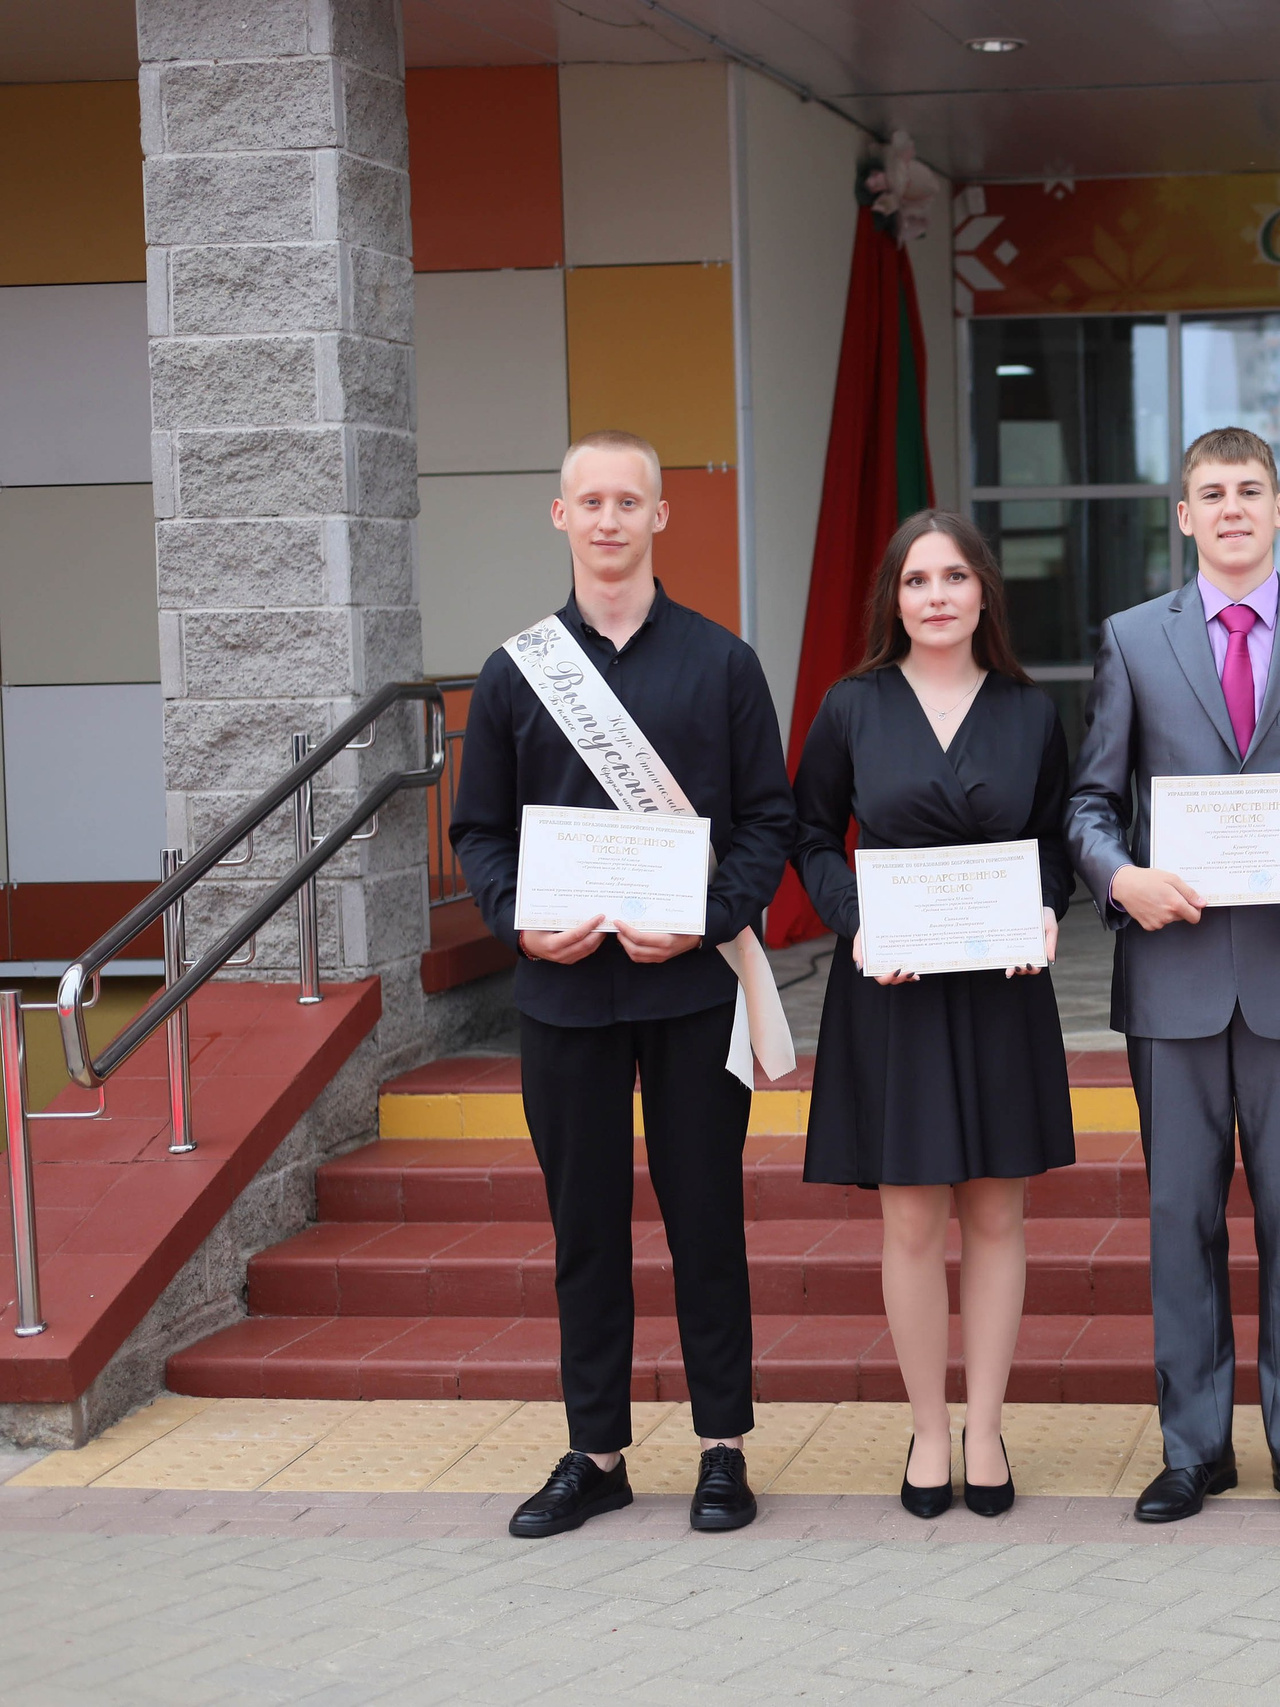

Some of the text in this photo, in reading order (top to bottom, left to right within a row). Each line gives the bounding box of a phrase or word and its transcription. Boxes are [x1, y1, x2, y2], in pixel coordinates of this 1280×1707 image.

[557, 708, 577, 733] класс
[543, 661, 659, 813] Выпускни
[606, 714, 686, 814] Крук Станислав
[600, 764, 624, 797] Средняя
[1219, 813, 1263, 823] ПИСЬМО
[556, 832, 675, 848] БЛАГОДАРСТВЕННОЕ
[591, 844, 639, 855] ПИСЬМО
[891, 869, 1007, 885] БЛАГОДАРСТВЕННОЕ
[927, 883, 972, 894] ПИСЬМО
